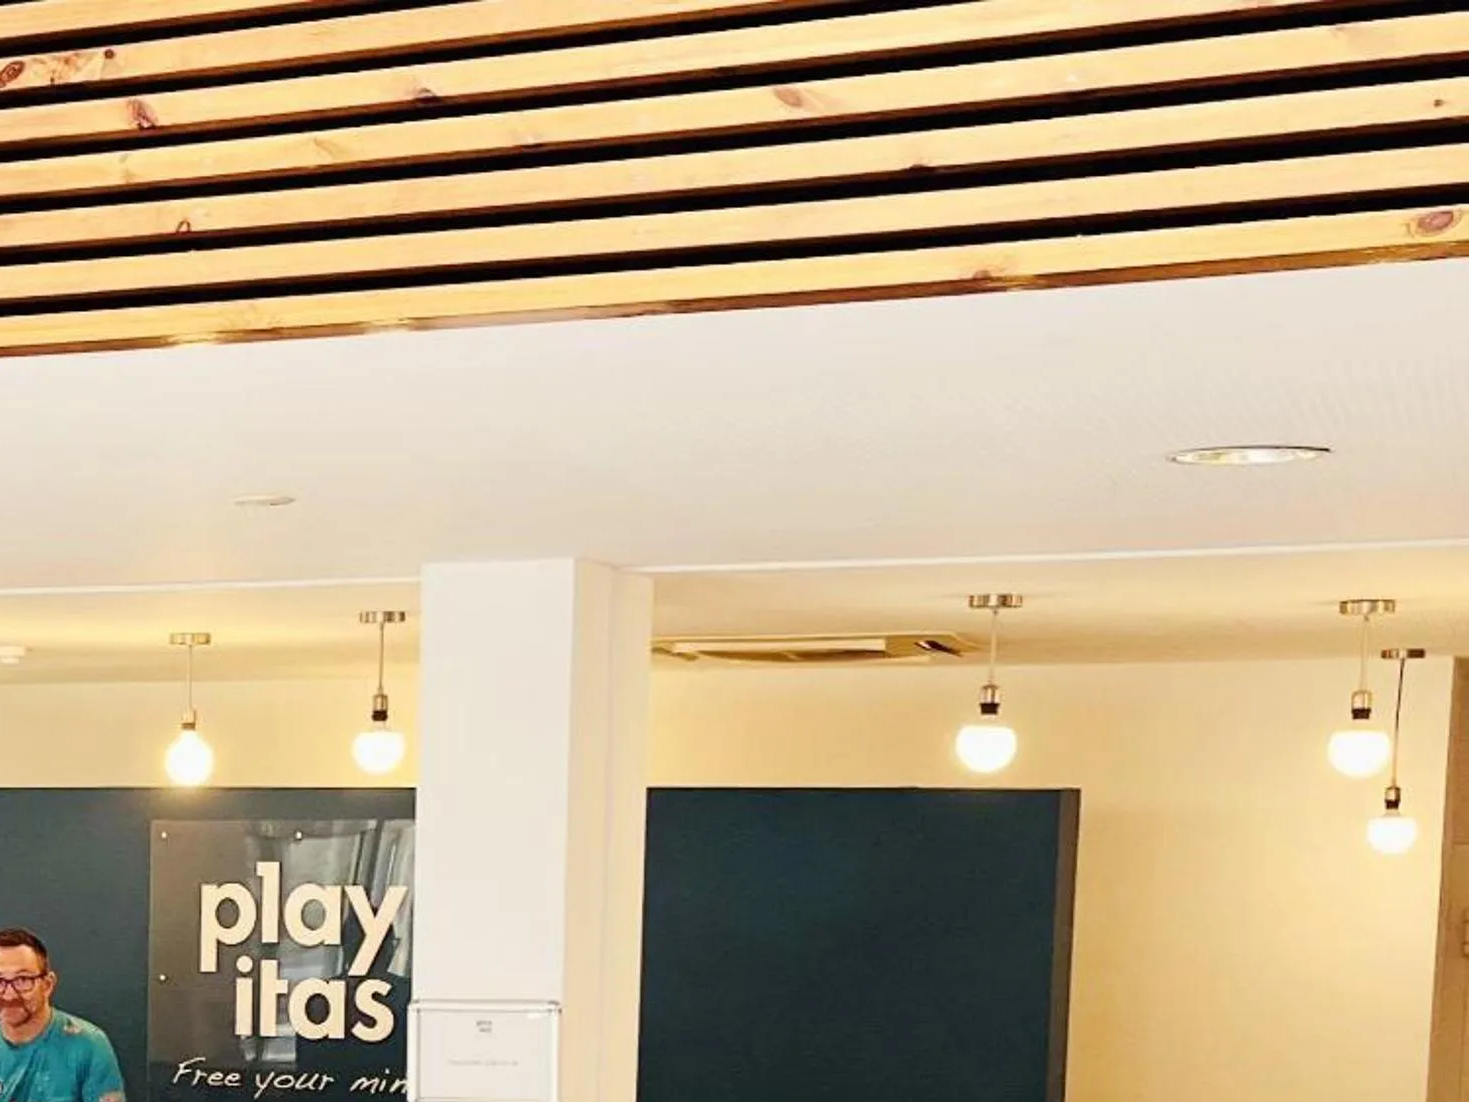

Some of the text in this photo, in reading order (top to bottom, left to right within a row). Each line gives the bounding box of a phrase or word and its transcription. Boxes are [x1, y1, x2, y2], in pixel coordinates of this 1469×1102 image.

[199, 861, 408, 976] play
[233, 955, 395, 1043] itas
[172, 1057, 408, 1099] Free your min
